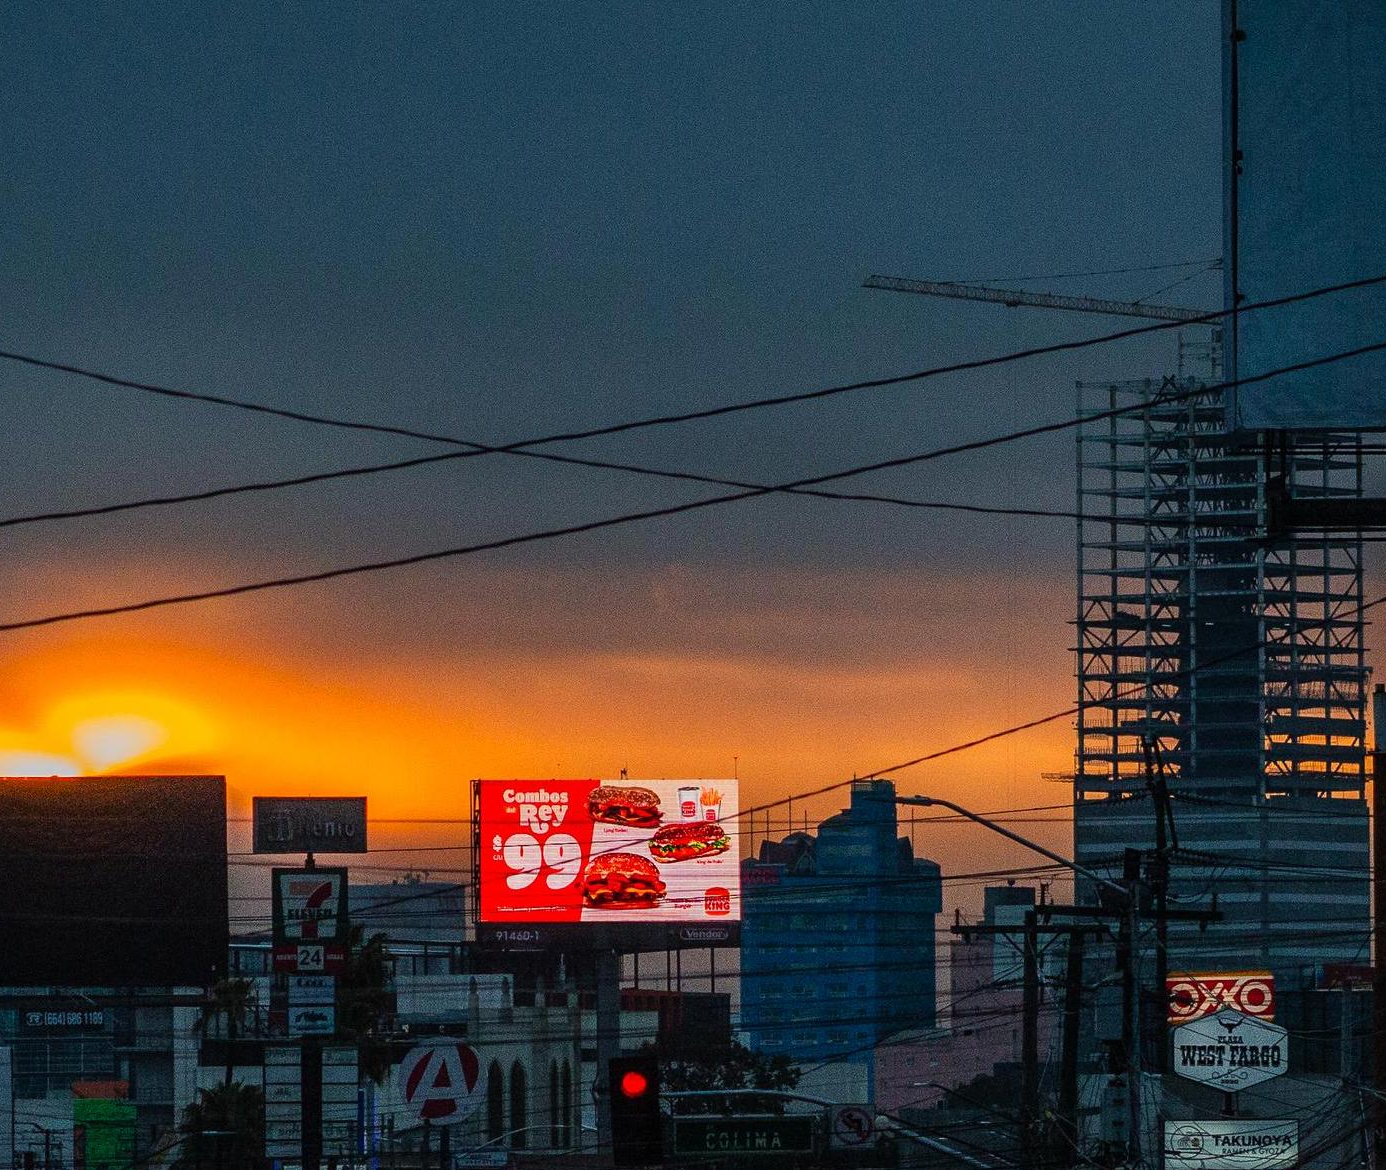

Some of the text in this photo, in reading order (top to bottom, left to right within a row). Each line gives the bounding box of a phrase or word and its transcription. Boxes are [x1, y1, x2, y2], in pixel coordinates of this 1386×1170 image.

[503, 789, 569, 803] Combos
[519, 803, 569, 834] Rey
[503, 833, 582, 891] 99
[705, 902, 731, 911] KING
[299, 949, 323, 966] 24
[1168, 978, 1274, 1018] OXXO
[1181, 1045, 1281, 1067] WEST FARGO
[706, 1132, 782, 1149] COLIMA
[1213, 1135, 1292, 1147] TAKUNOYA
